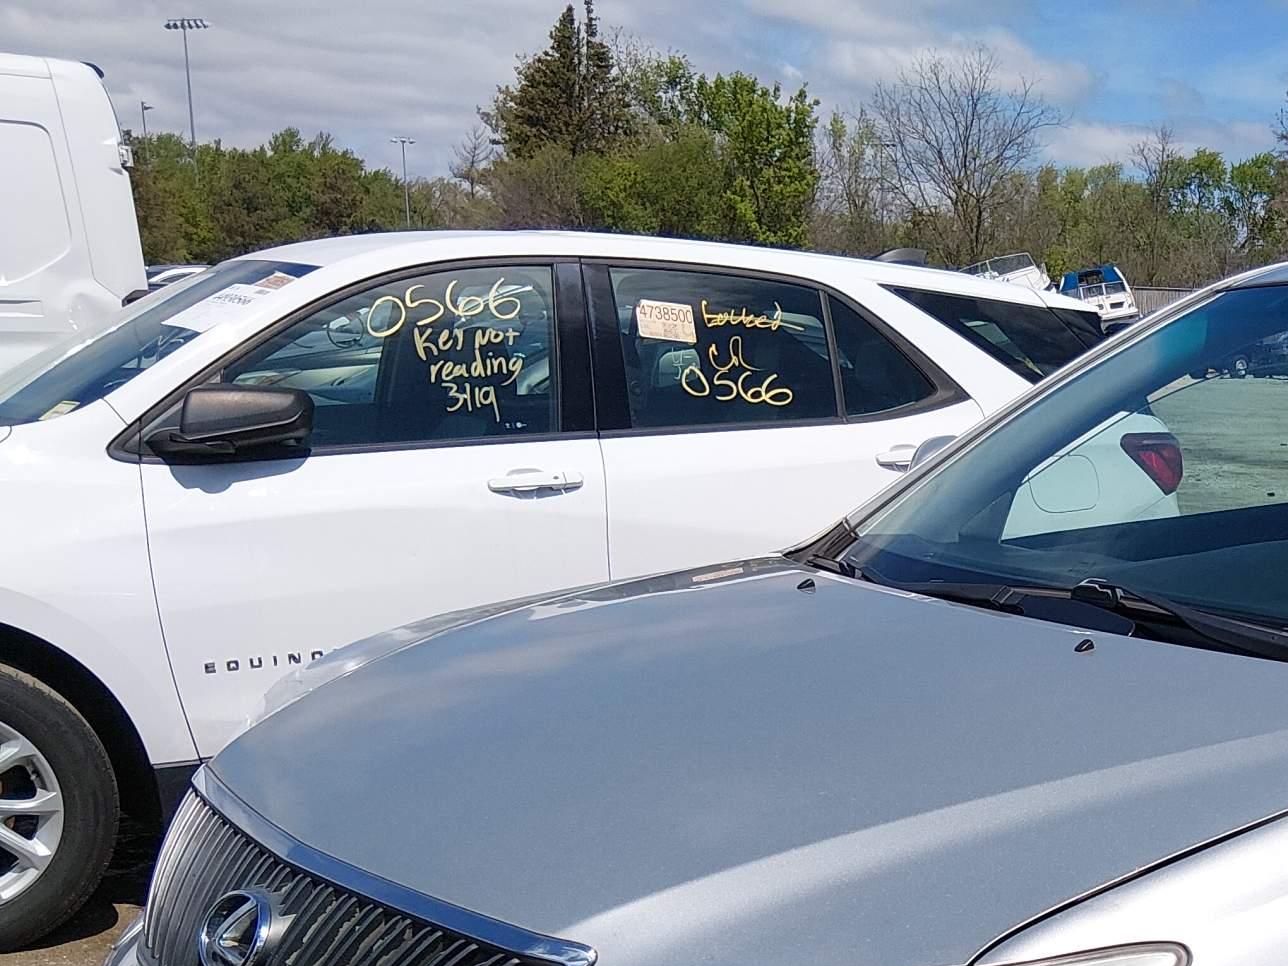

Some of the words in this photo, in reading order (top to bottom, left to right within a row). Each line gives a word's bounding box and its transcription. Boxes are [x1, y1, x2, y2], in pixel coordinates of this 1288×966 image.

[367, 277, 522, 337] 0566
[430, 351, 523, 386] reading
[681, 370, 793, 406] 0566
